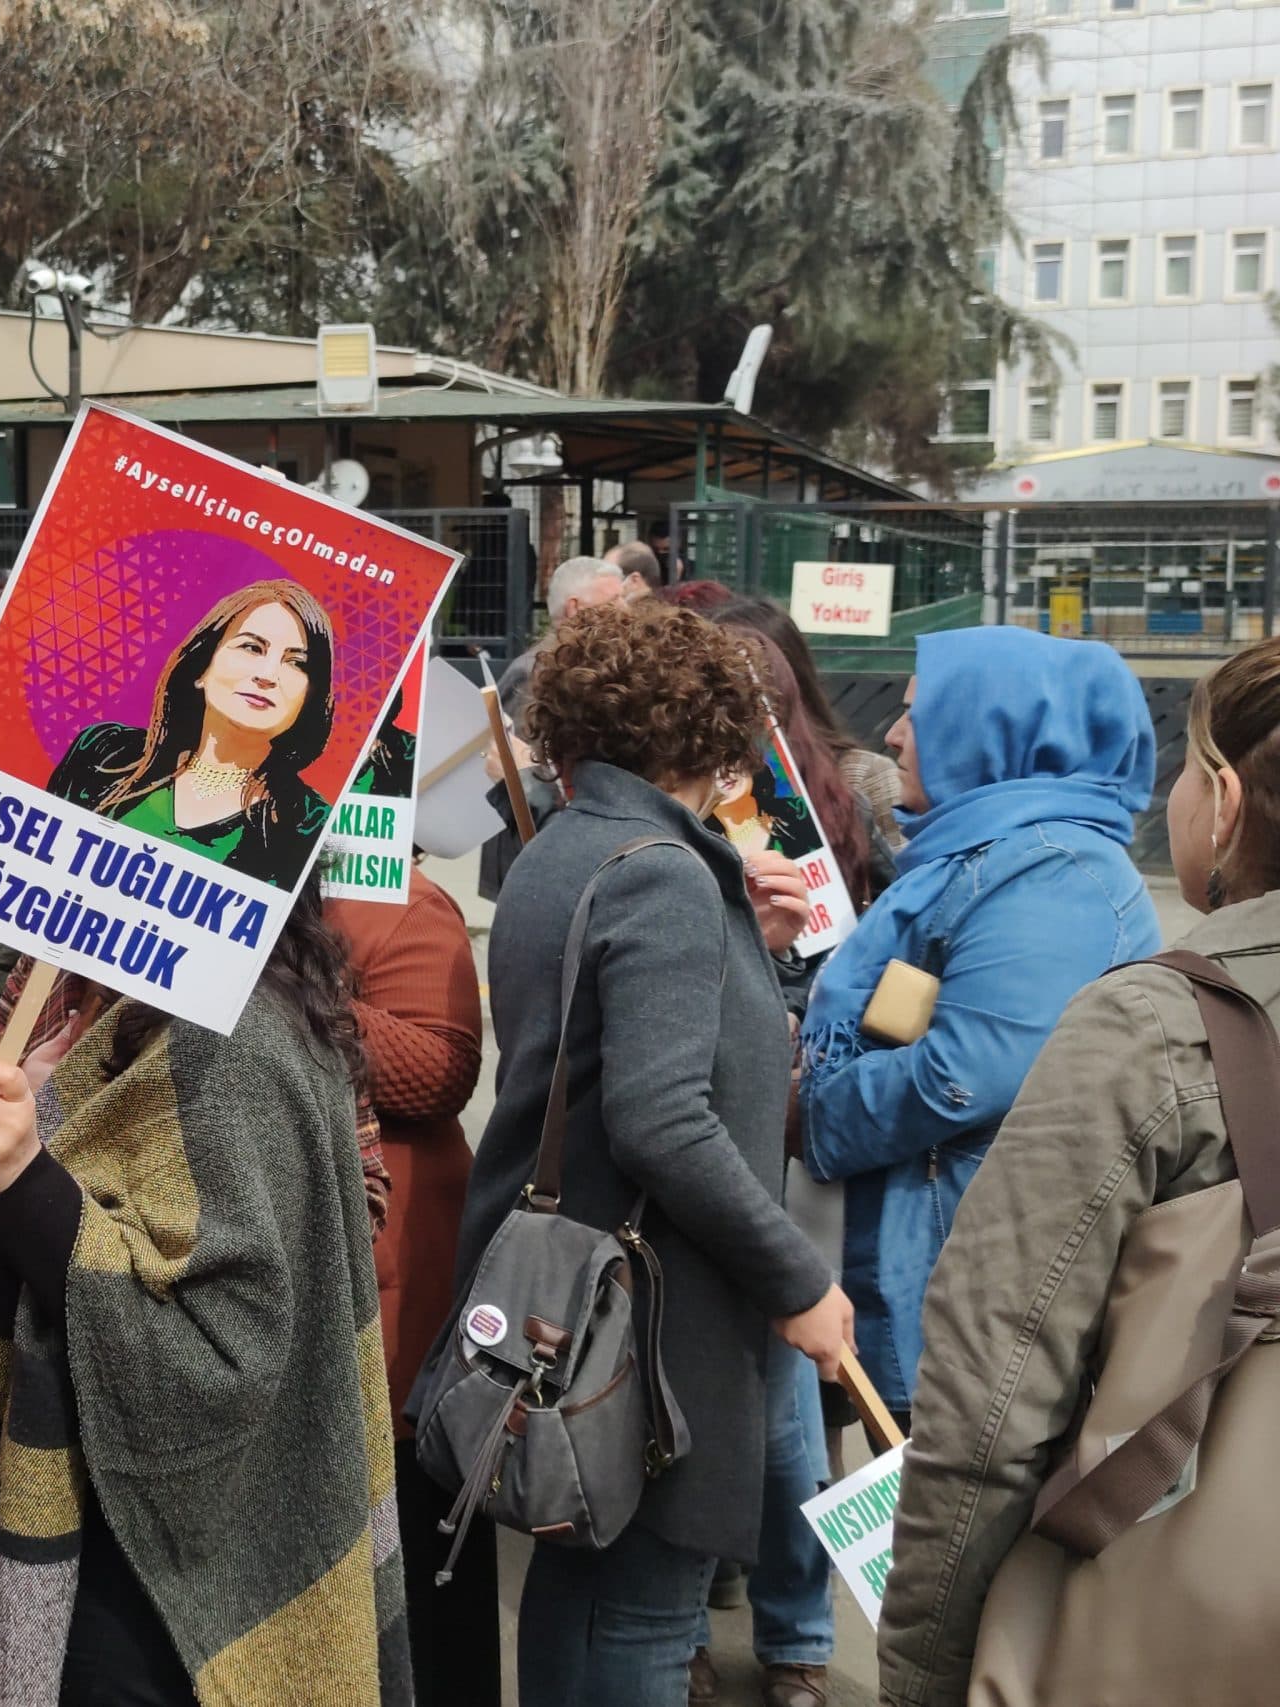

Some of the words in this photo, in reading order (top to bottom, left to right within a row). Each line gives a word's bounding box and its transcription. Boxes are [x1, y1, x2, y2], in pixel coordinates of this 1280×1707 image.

[114, 454, 396, 585] #AyselİçinGeçOlmadan
[811, 602, 872, 623] Yoktur
[821, 567, 864, 592] Giriş
[68, 828, 269, 949] TUĞLUK'A
